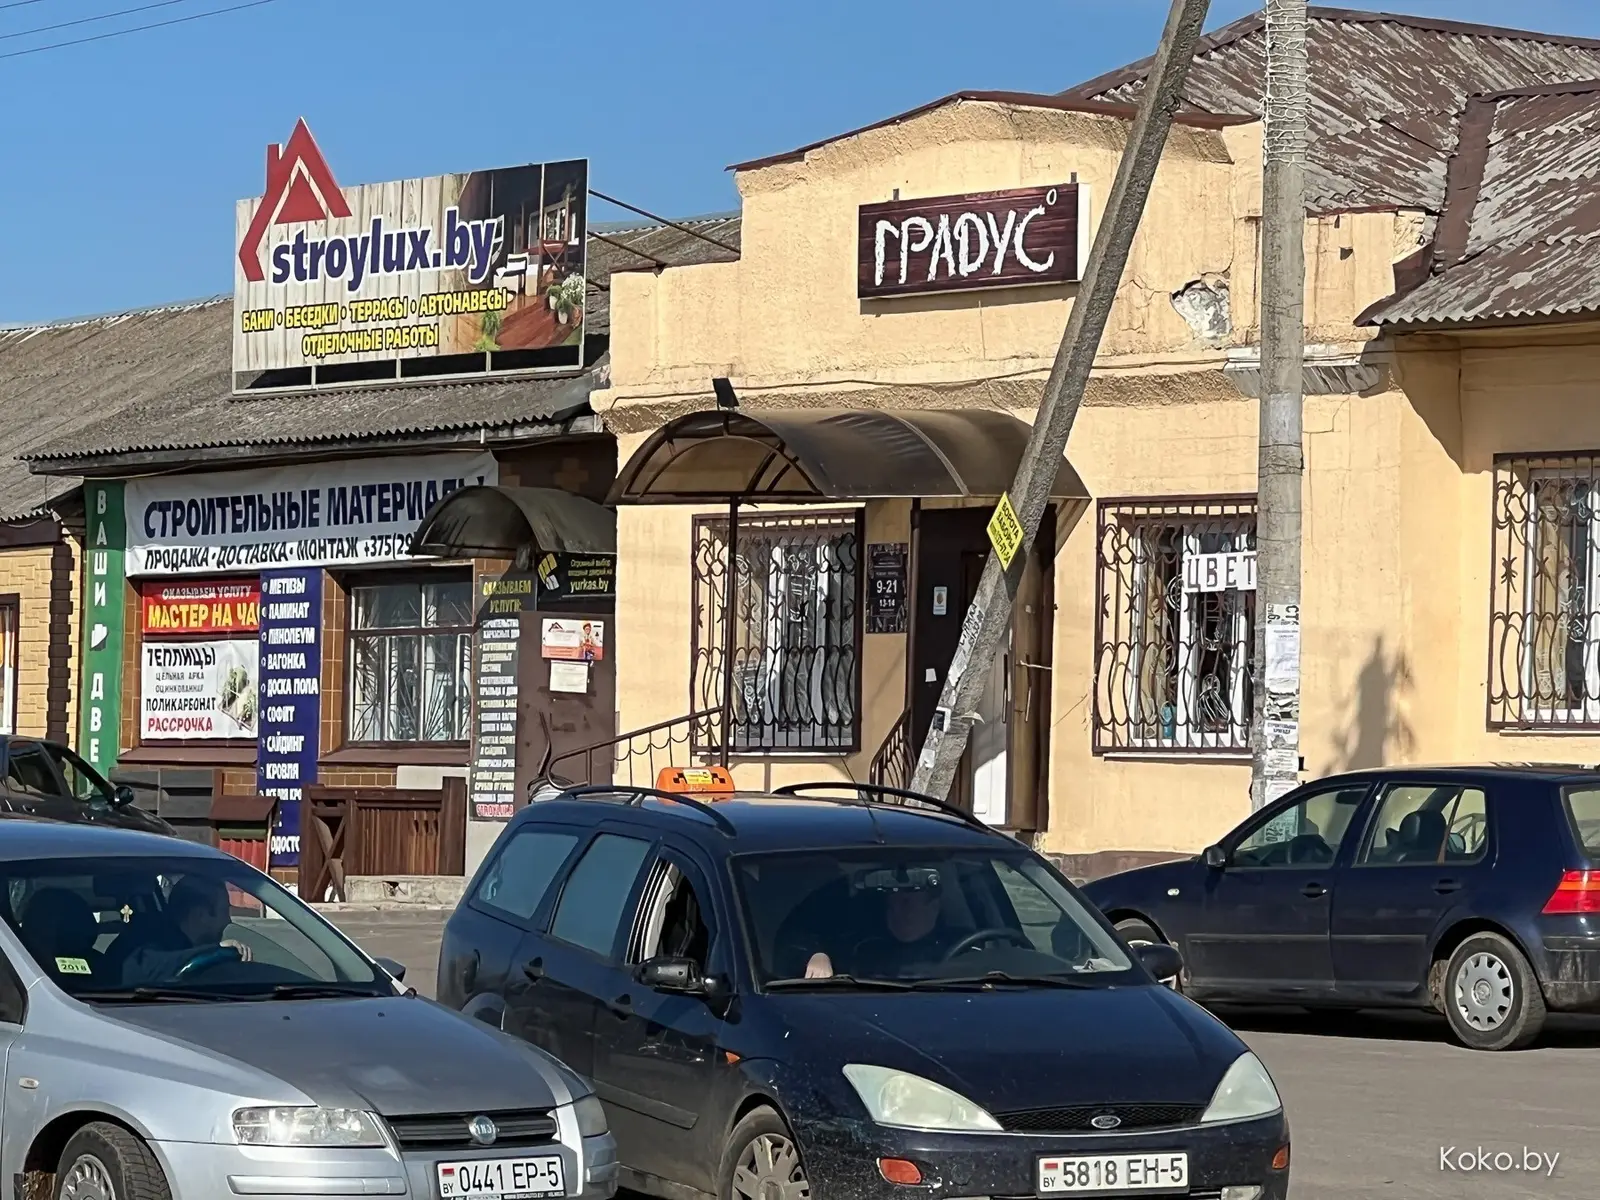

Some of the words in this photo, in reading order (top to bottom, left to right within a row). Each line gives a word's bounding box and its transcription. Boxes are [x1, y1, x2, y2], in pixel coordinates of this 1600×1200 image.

[272, 209, 497, 291] stroylux.by
[242, 309, 274, 332] БАНИ
[285, 305, 339, 330] БЕСЕДКИ
[349, 297, 407, 322] ТЕРРАСЫ
[419, 287, 507, 317] АВТОНАВЕСЫ
[302, 329, 383, 358] ОТДЕЛОЧНЫЕ
[385, 325, 439, 350] РАБОТЫ
[144, 489, 320, 539] СТРОИТЕЛЬНЫЕ
[327, 476, 484, 525] МАТЕРИА
[145, 547, 209, 572] ПРОДАЖА
[216, 541, 289, 569] ДОСТАВКА
[296, 537, 359, 562] МОНТАЖ
[1187, 555, 1257, 592] ЦВЕТ
[269, 577, 306, 595] МЕТИЗЫ
[570, 577, 609, 593] yurkas.by
[876, 579, 898, 594] 9-21
[148, 603, 209, 628] МАСТЕР
[212, 603, 233, 627] НА
[269, 602, 310, 620] ЛАМИНАТ
[268, 627, 316, 645] ЛИНОЛЕУМ
[147, 647, 216, 670] ТЕПЛИЦЫ
[267, 652, 306, 670] ВАГОНКА
[267, 678, 293, 698] ДОСКА
[293, 677, 319, 695] ПОЛА
[146, 697, 217, 711] ПОЛИКАРБОНАТ
[267, 705, 295, 723] СОФИТ
[90, 672, 105, 764] ДВЕ
[148, 717, 214, 732] РАССРОЧКА
[267, 731, 304, 755] САЙДИНГ
[266, 763, 299, 780] КРОВЛЯ
[459, 1164, 504, 1193] 0441
[512, 1161, 559, 1190] EP-5
[1043, 1177, 1056, 1188] BY
[1063, 1160, 1118, 1188] 5818
[1127, 1158, 1183, 1186] EH-5
[443, 1183, 454, 1194] BY
